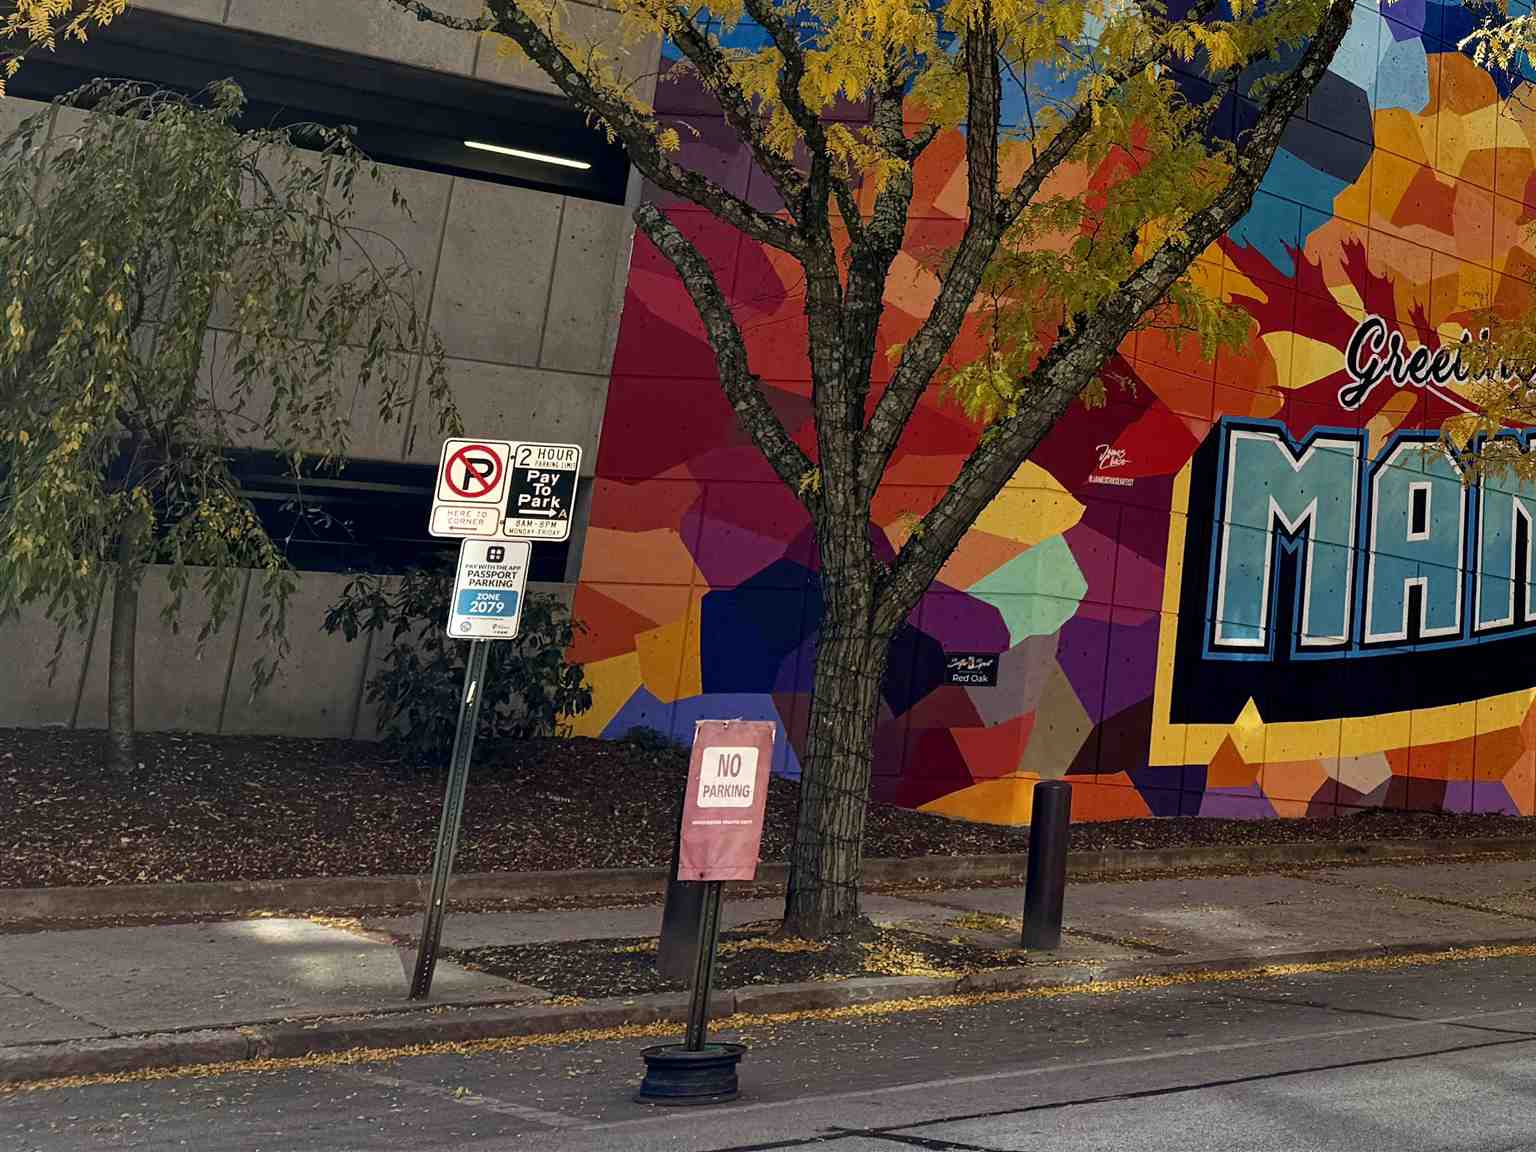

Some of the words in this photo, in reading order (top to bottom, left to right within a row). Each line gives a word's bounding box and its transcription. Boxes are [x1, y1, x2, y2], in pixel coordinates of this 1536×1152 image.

[519, 448, 532, 466] 2
[537, 447, 574, 461] HOUR
[526, 470, 560, 486] Pay
[532, 483, 552, 496] To
[518, 493, 561, 508] Park
[467, 570, 518, 580] PASSPORT
[468, 578, 513, 588] PARKING
[476, 592, 501, 601] ZONE
[469, 601, 505, 614] 2079
[952, 673, 969, 682] Red
[970, 674, 989, 683] Oak
[717, 753, 742, 778] NO
[703, 783, 751, 798] PARKING
